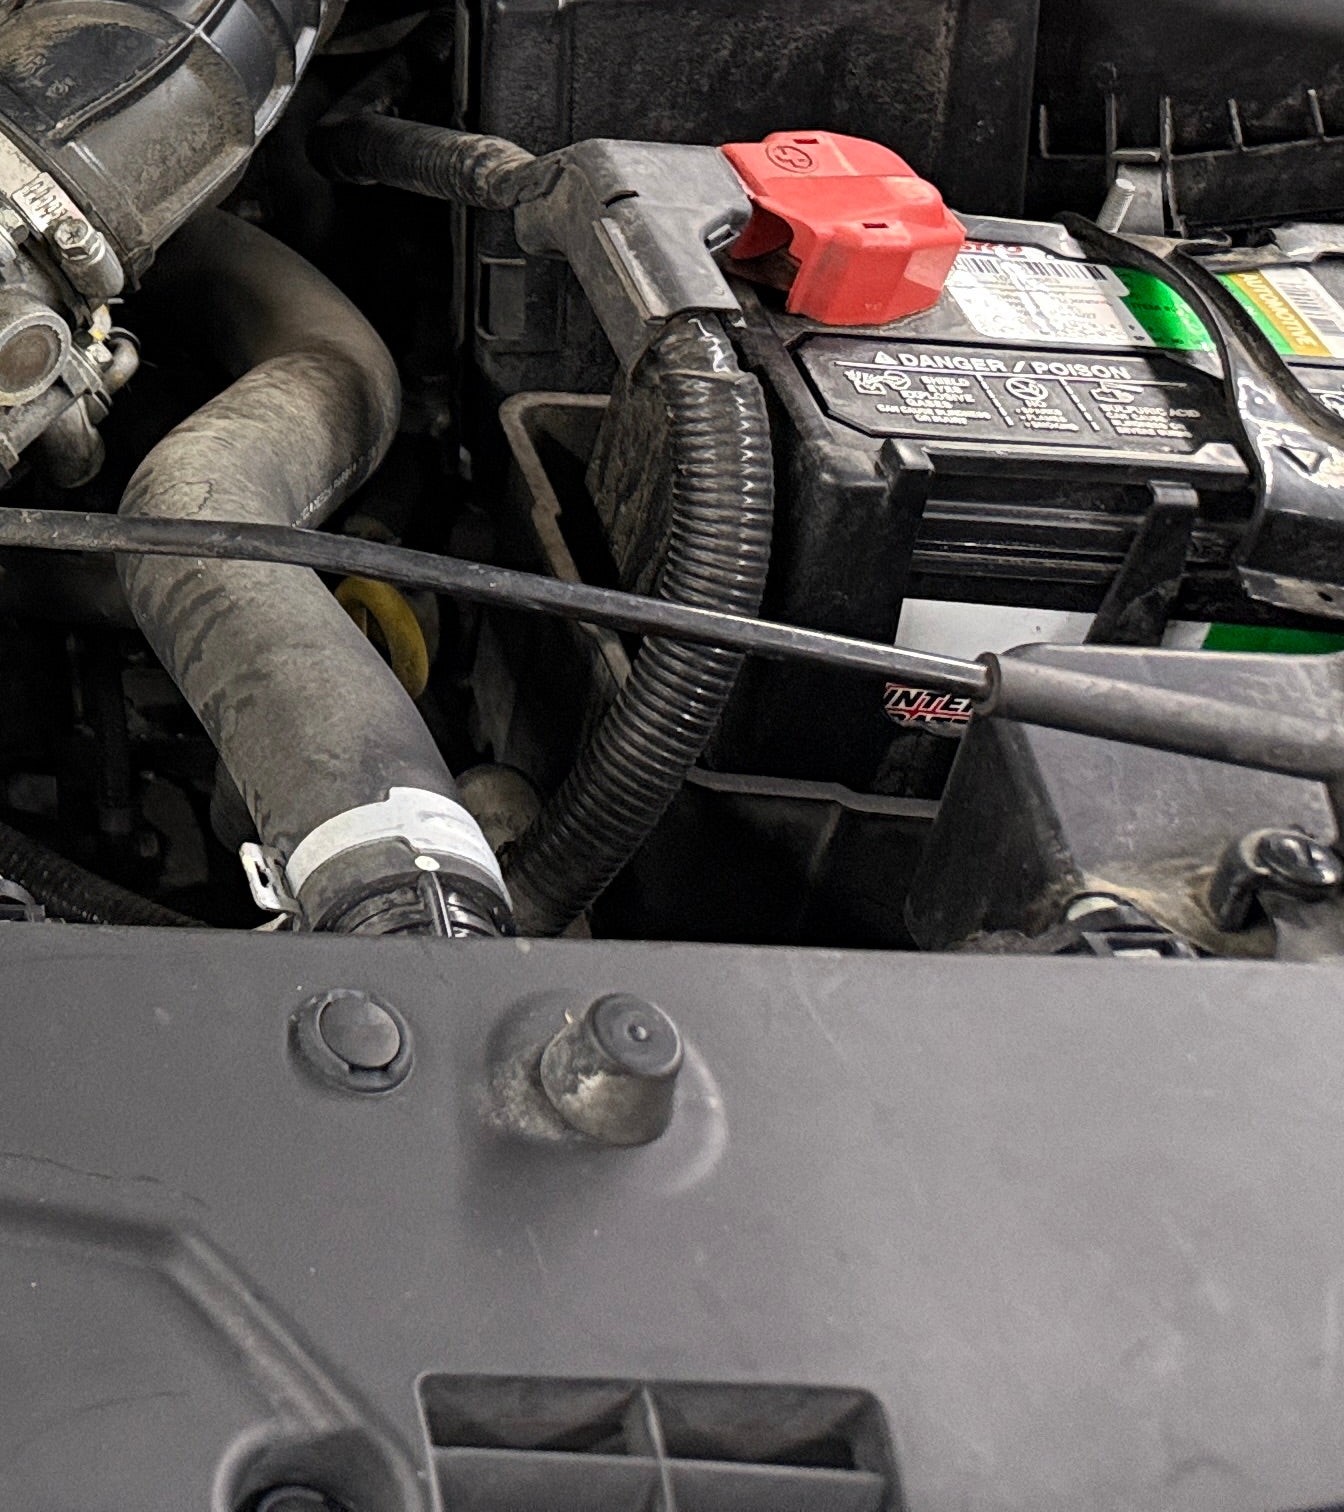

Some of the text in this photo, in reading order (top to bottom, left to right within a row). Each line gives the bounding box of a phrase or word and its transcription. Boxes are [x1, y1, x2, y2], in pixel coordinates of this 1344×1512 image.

[1237, 273, 1318, 348] AUTOMOTIVE
[896, 353, 1007, 372] DANGER
[1032, 361, 1132, 379] POISON
